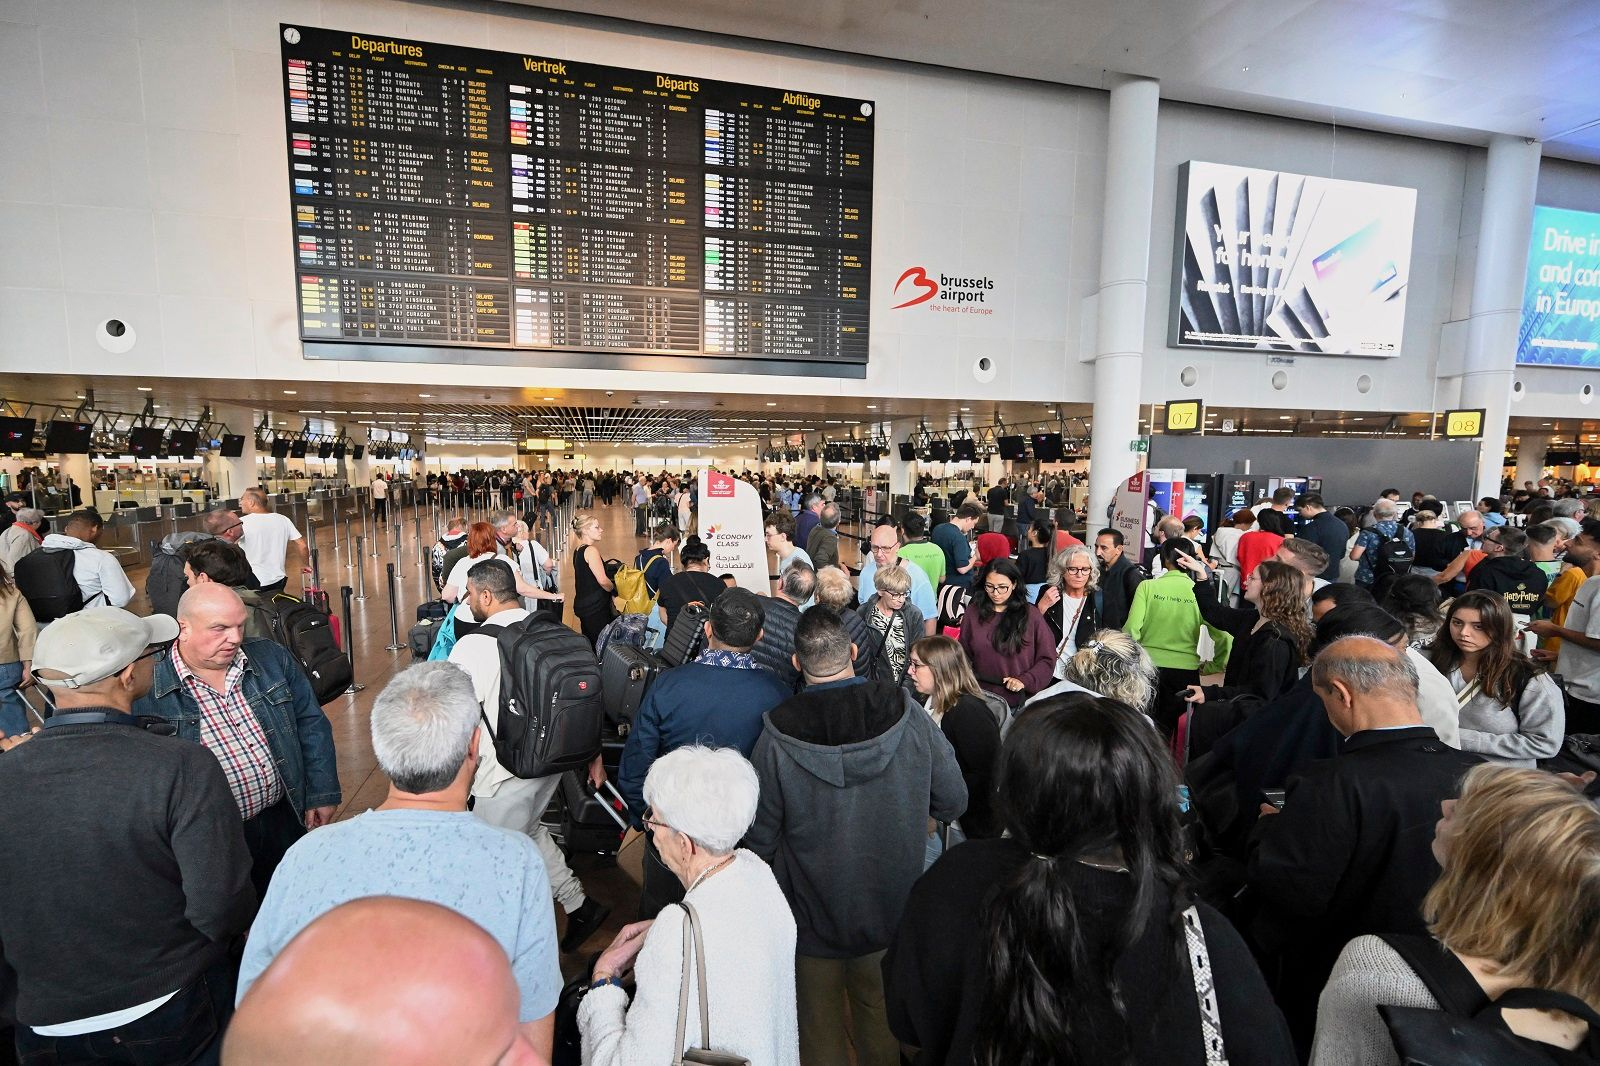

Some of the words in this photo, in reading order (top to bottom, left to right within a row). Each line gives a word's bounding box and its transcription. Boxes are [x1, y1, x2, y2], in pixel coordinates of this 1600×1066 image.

[352, 36, 422, 58] Departures
[523, 57, 567, 76] Vertrek
[656, 75, 699, 92] Départs
[782, 92, 821, 110] Abflüge
[1543, 227, 1586, 255] Drive
[1540, 261, 1572, 285] and
[940, 274, 994, 290] brussels
[940, 288, 984, 303] airport
[1536, 289, 1552, 313] in
[970, 306, 992, 314] Europe
[1172, 412, 1192, 425] 07
[1452, 420, 1474, 432] 08
[1120, 516, 1140, 524] BUSINESS
[1504, 592, 1520, 602] Harry
[1520, 591, 1539, 602] Potter
